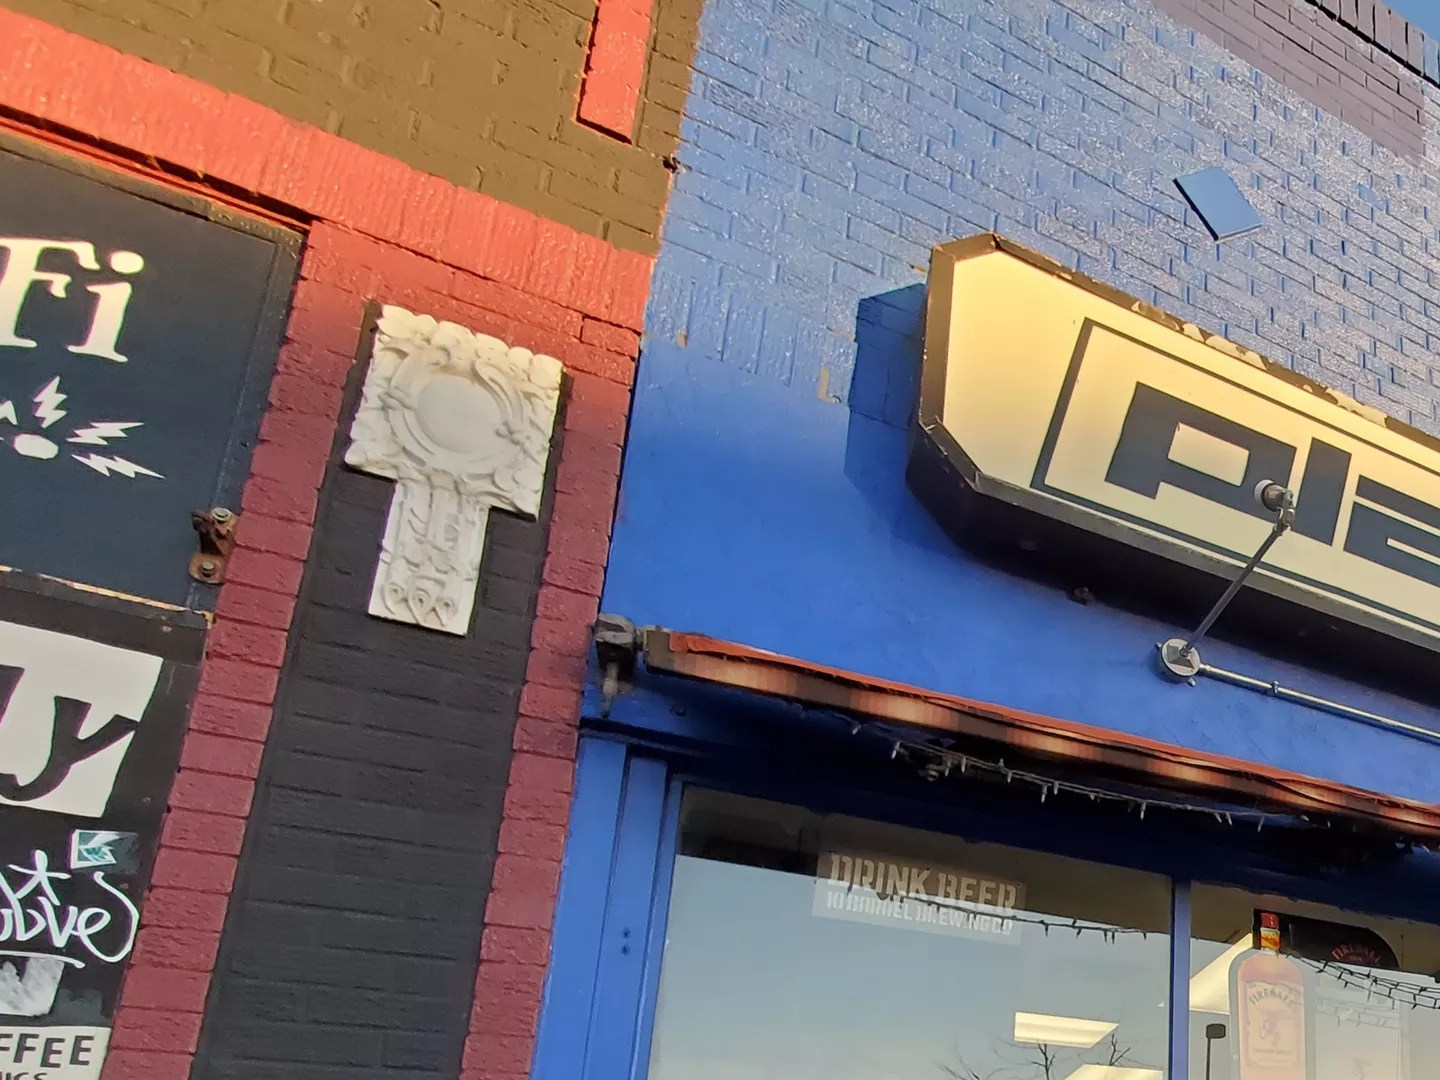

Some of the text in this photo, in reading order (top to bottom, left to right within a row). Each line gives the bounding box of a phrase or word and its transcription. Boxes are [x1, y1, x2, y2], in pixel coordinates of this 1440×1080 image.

[0, 664, 140, 802] y
[828, 853, 1017, 915] DRINK BEER
